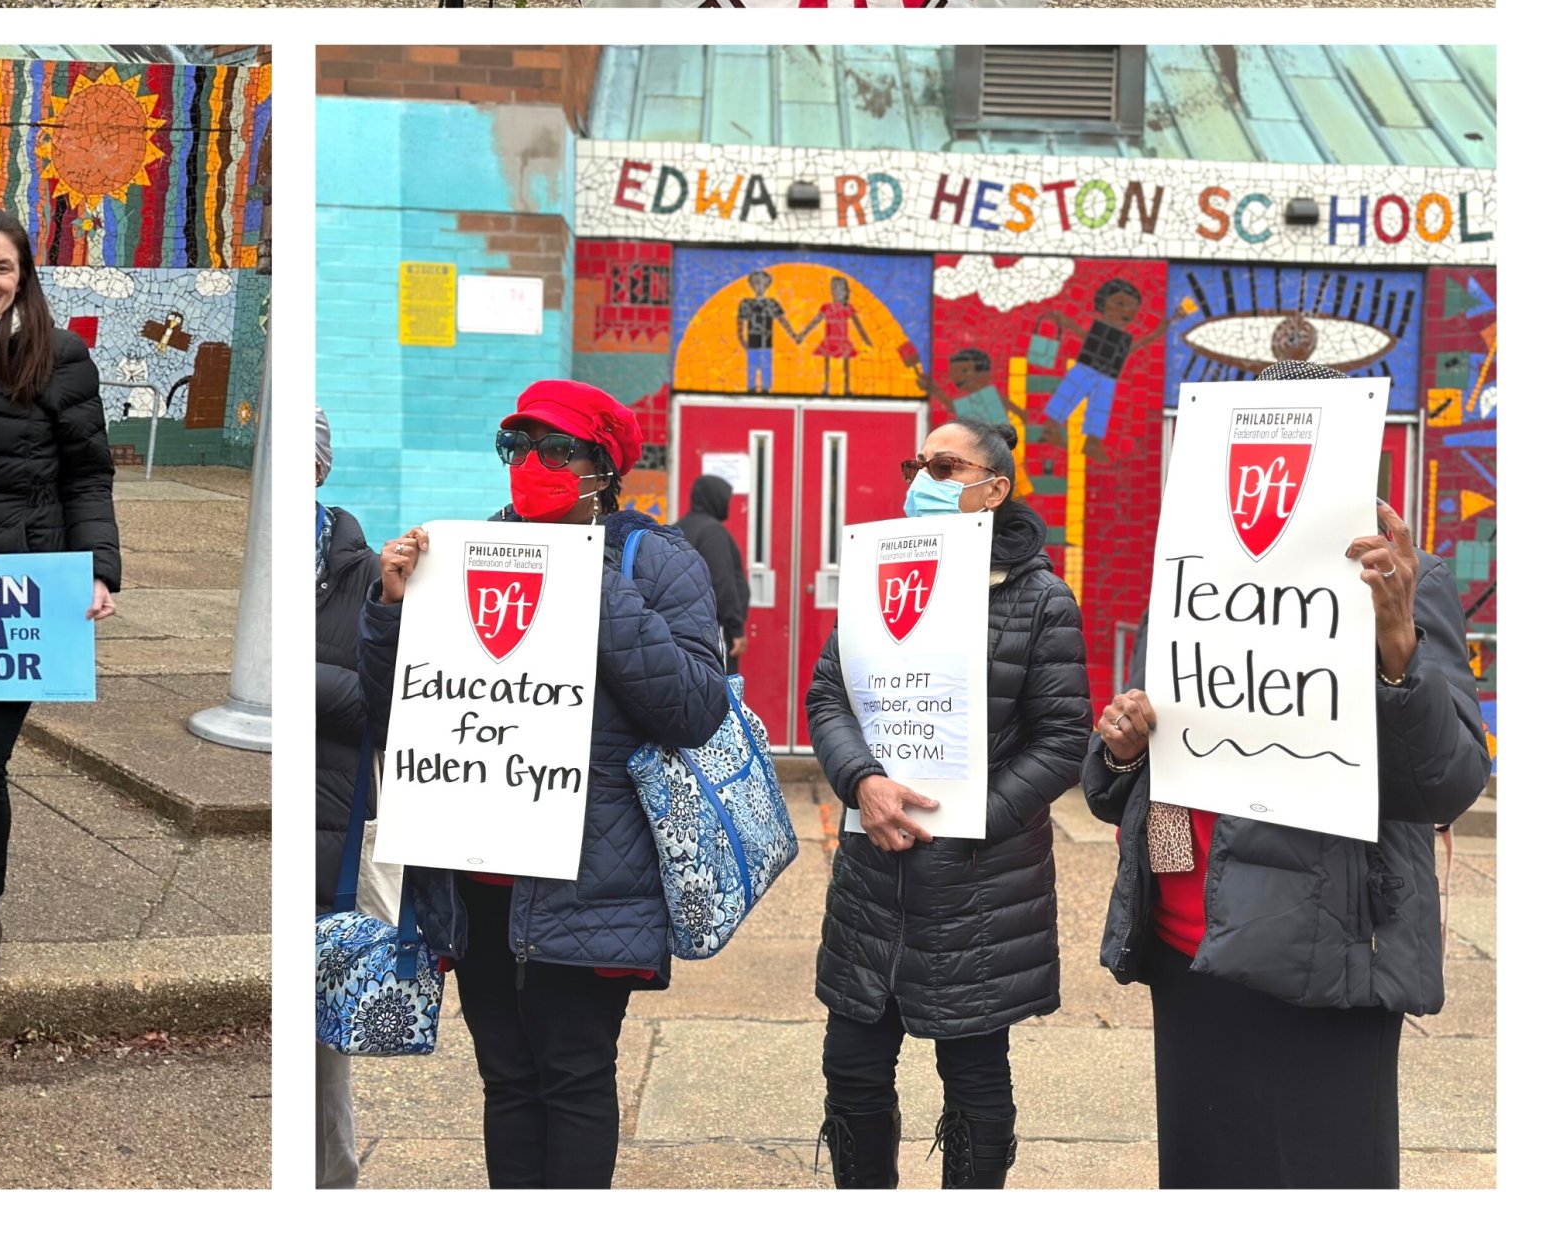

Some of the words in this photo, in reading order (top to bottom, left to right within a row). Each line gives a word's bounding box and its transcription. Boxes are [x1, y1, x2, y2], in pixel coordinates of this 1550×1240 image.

[614, 159, 903, 227] EDWARD
[930, 173, 1164, 234] HESTON
[1195, 184, 1496, 248] SCHOOL
[1235, 412, 1313, 426] PHILADELPHIA
[1233, 427, 1270, 440] Federation
[1270, 427, 1279, 439] of
[1280, 427, 1313, 440] Teachers
[1232, 455, 1296, 530] pft
[469, 545, 543, 559] PHILADELPHIA
[880, 538, 938, 551] PHILADELPHIA
[468, 557, 504, 567] Federation
[504, 559, 512, 568] of
[513, 559, 543, 570] Teachers
[882, 569, 929, 624] pft
[1165, 554, 1339, 639] Team
[474, 581, 533, 640] pft
[10, 627, 40, 641] FOR
[400, 662, 584, 707] Educators
[868, 674, 886, 689] I'm
[890, 676, 901, 689] a
[905, 672, 932, 689] PFT
[1170, 640, 1338, 721] Helen
[863, 696, 912, 714] member,
[916, 696, 953, 713] and
[451, 711, 519, 746] for
[883, 719, 935, 740] voting
[868, 743, 892, 759] ELEN
[896, 743, 945, 761] GYM!
[395, 748, 487, 784] Helen
[505, 753, 581, 802] Gym
